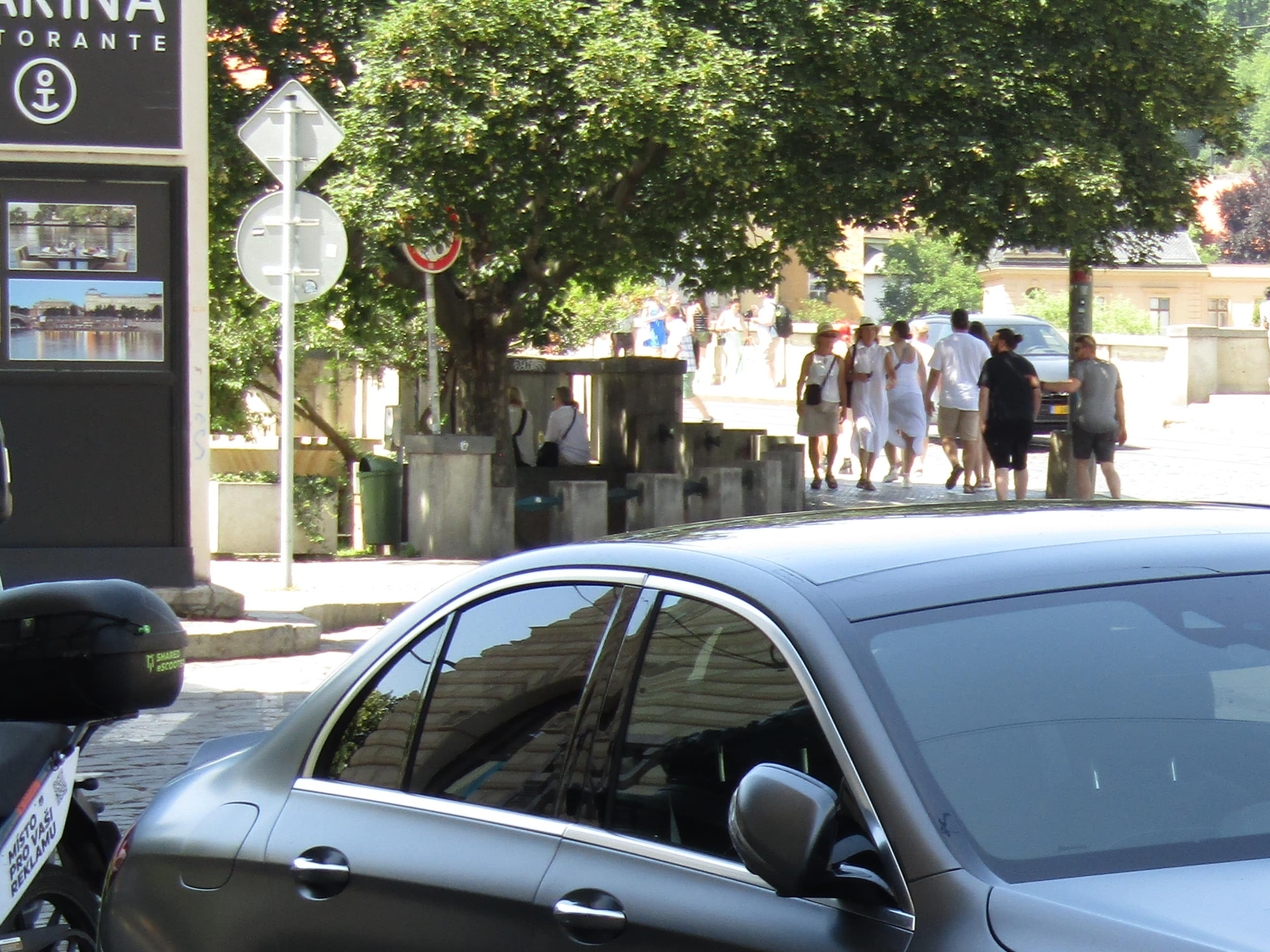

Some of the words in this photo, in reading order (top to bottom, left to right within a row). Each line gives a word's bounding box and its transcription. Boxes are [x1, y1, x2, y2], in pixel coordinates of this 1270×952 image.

[8, 813, 37, 865] MÍSTO
[9, 844, 30, 881] PRO
[31, 807, 54, 846] VAŠI
[10, 821, 57, 898] REKLAMU
